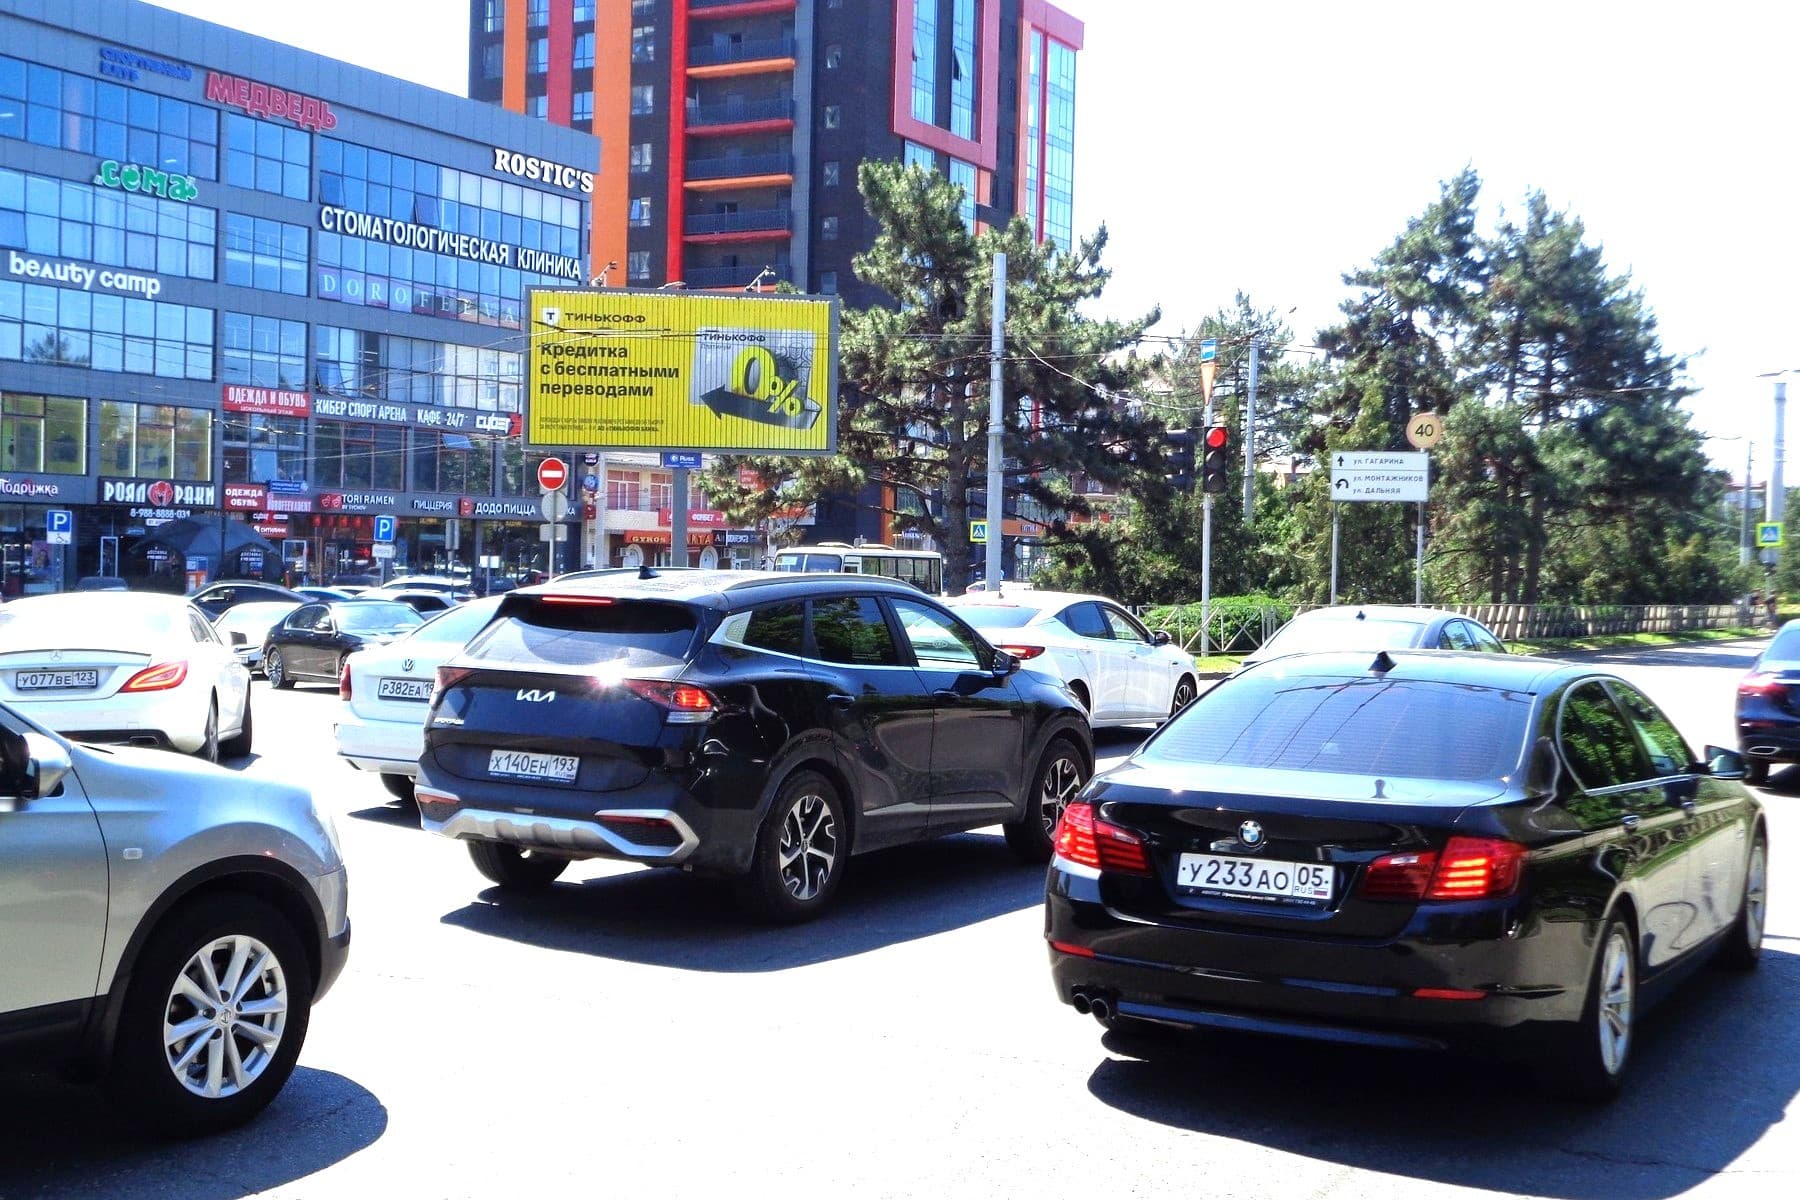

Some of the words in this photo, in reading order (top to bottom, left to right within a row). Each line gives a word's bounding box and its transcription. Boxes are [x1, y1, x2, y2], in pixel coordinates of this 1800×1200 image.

[204, 70, 338, 133] МЕДВЕДЬ
[494, 148, 593, 193] ROSTIC'S
[320, 206, 509, 266] СТОМАТОЛОГИЧЕСКАЯ
[516, 248, 582, 280] КЛИНИКА
[99, 269, 160, 298] camp
[565, 312, 646, 323] ТИНЬКОФФ
[703, 333, 766, 342] ТИНЬКОФФ
[541, 343, 628, 359] Кредитка
[554, 361, 679, 378] бесплатными
[730, 345, 804, 417] 0%
[228, 387, 267, 405] ОДЕЖДА
[270, 391, 276, 404] И
[278, 391, 306, 407] ОБУВЬ
[540, 383, 654, 397] переводами
[316, 399, 347, 416] КИБЕР
[348, 402, 378, 419] СПОРТ
[378, 405, 407, 421] АРЕНА
[417, 409, 441, 425] КАФЕ
[1415, 423, 1434, 437] 40
[225, 488, 264, 498] ОДЕЖДА
[342, 494, 363, 505] TORI
[364, 495, 395, 505] RAMEN
[230, 498, 259, 508] ОБУВЬ
[412, 500, 453, 511] ПИЦЦЕРИЯ
[475, 503, 502, 514] ДОДО
[503, 504, 536, 516] ПИЦЦА
[381, 681, 421, 697] Р382ЕА
[492, 753, 549, 774] Х140ЕН
[552, 757, 575, 772] 193
[1190, 859, 1289, 891] У233АО
[1297, 866, 1324, 887] 05
[1295, 885, 1313, 895] RUS
